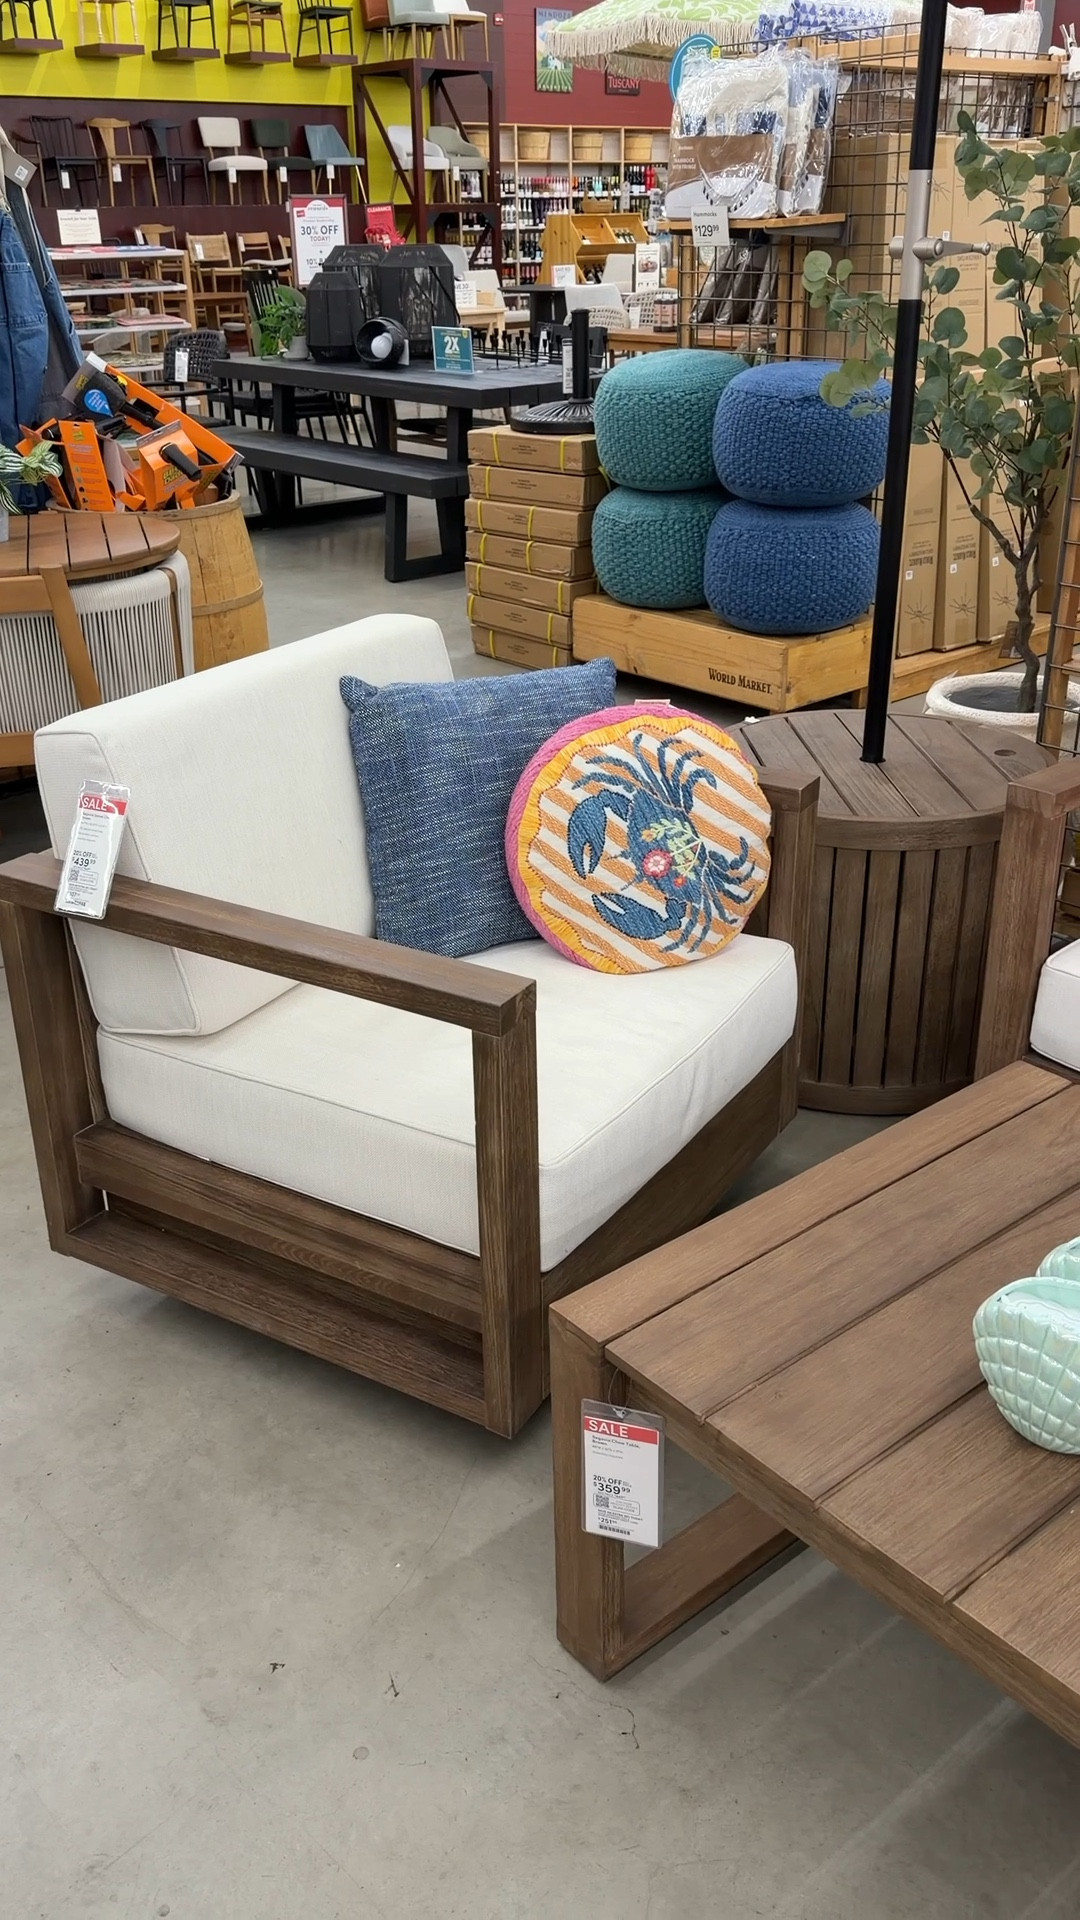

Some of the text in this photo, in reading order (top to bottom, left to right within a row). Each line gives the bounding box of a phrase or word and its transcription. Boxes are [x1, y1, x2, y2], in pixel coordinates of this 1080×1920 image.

[608, 76, 640, 89] TUSCANY
[300, 225, 339, 236] 30% OFF
[444, 335, 460, 354] 2X
[708, 667, 737, 686] WORLD
[83, 796, 108, 811] SALE
[589, 1419, 629, 1438] SALE
[593, 1474, 622, 1486] 20% OFF
